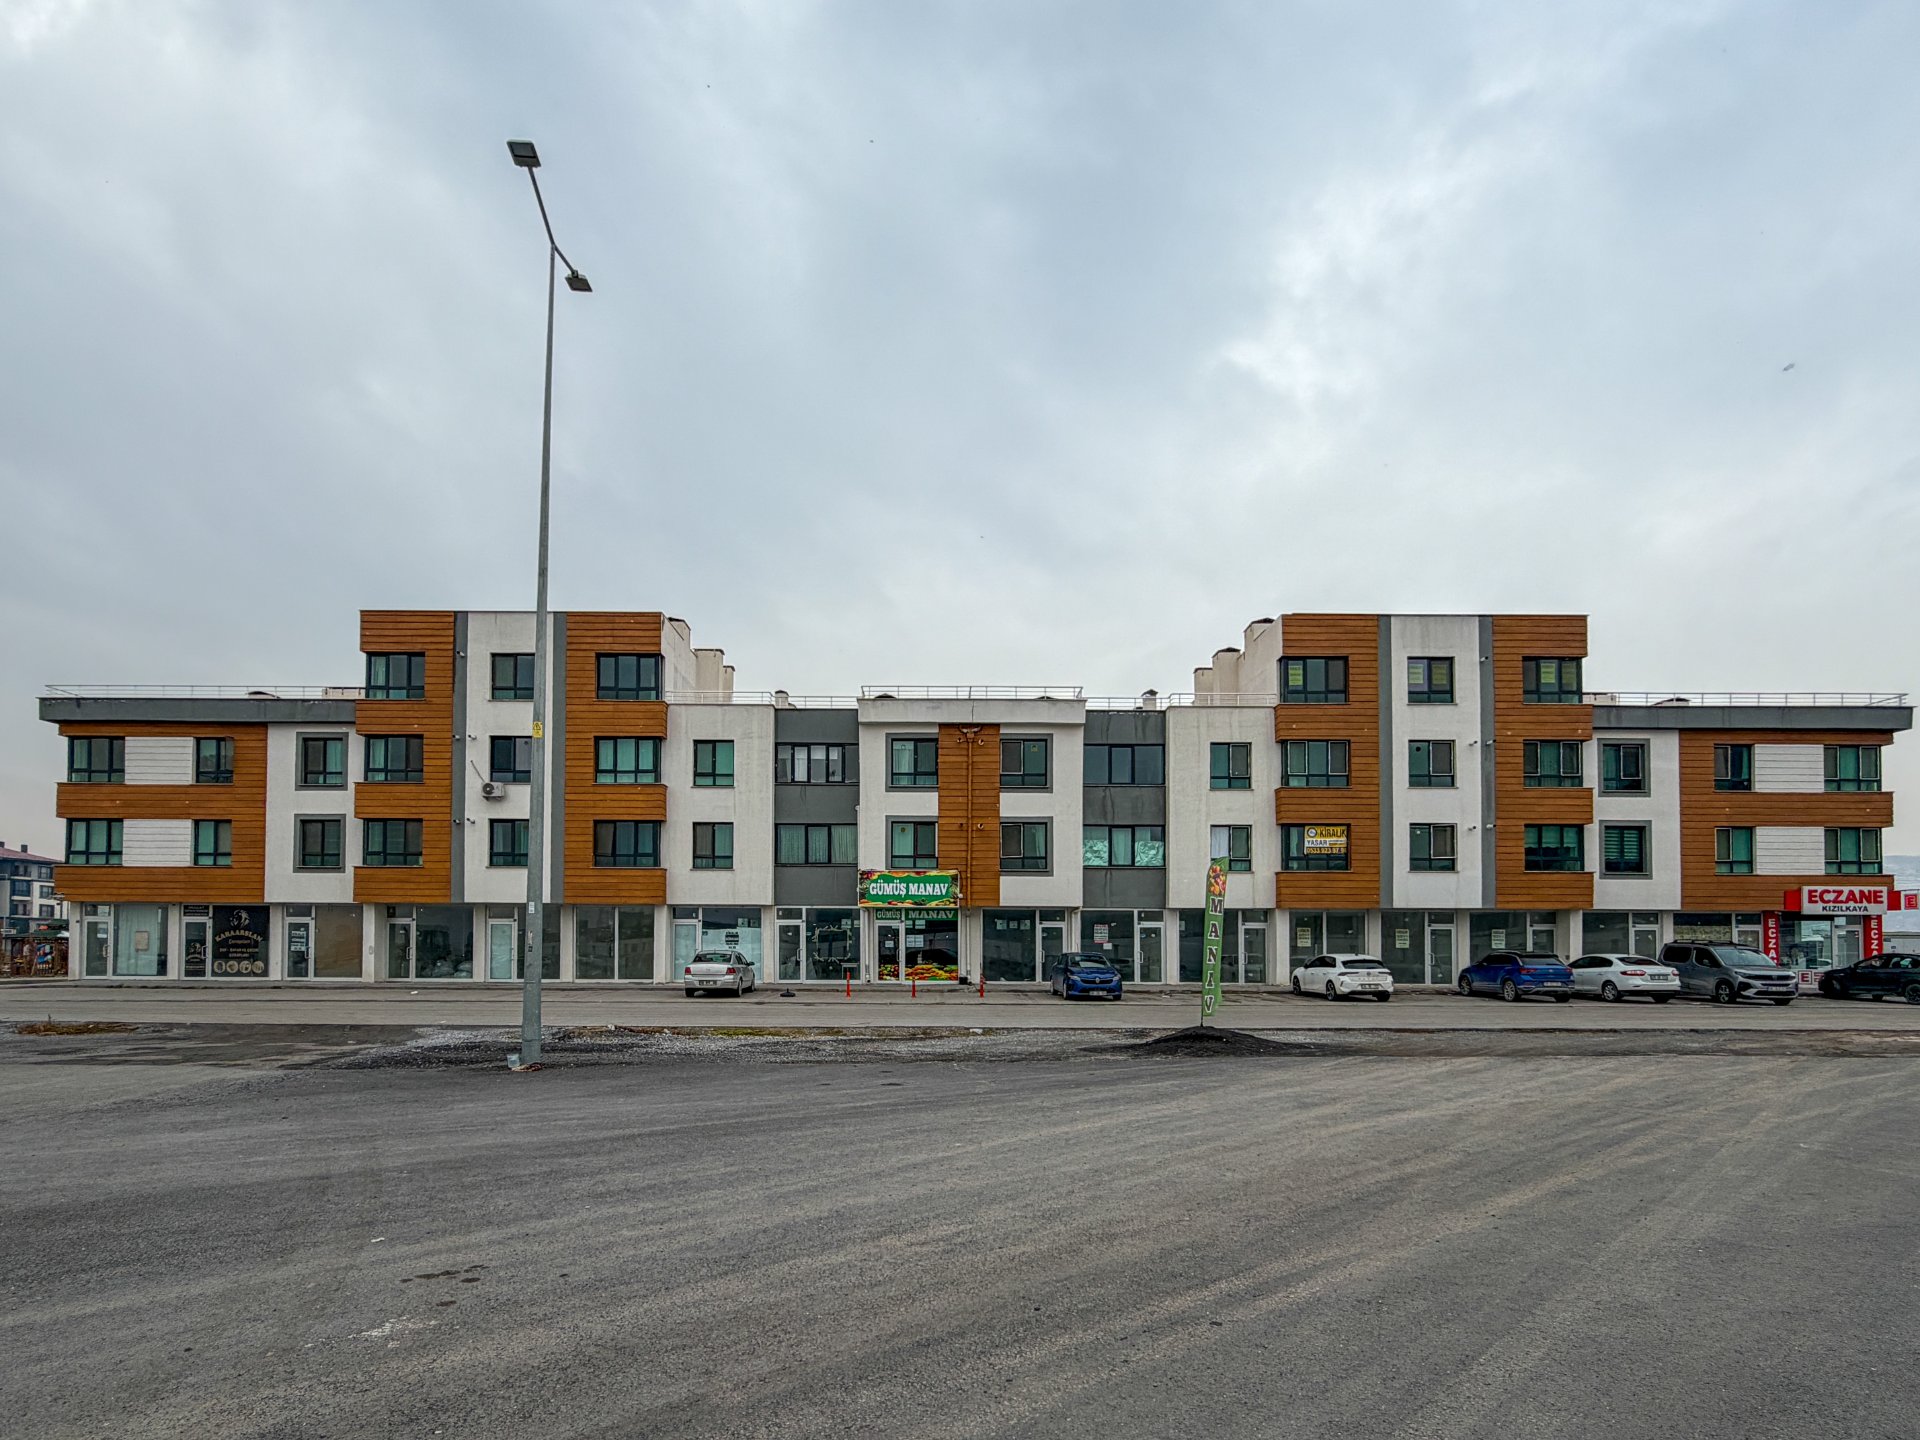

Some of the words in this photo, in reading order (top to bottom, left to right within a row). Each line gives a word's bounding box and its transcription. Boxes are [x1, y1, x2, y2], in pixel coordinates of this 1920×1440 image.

[870, 880, 907, 898] GÜMÜŞ
[909, 883, 949, 896] MANAV
[1807, 889, 1884, 905] ECZANE
[1822, 905, 1869, 913] KIZILKAYA
[1906, 895, 1916, 908] E
[877, 909, 901, 919] GÜMÜŞ
[909, 910, 954, 919] MANAV
[1768, 918, 1778, 964] ECZA
[1205, 897, 1223, 1013] MANAV
